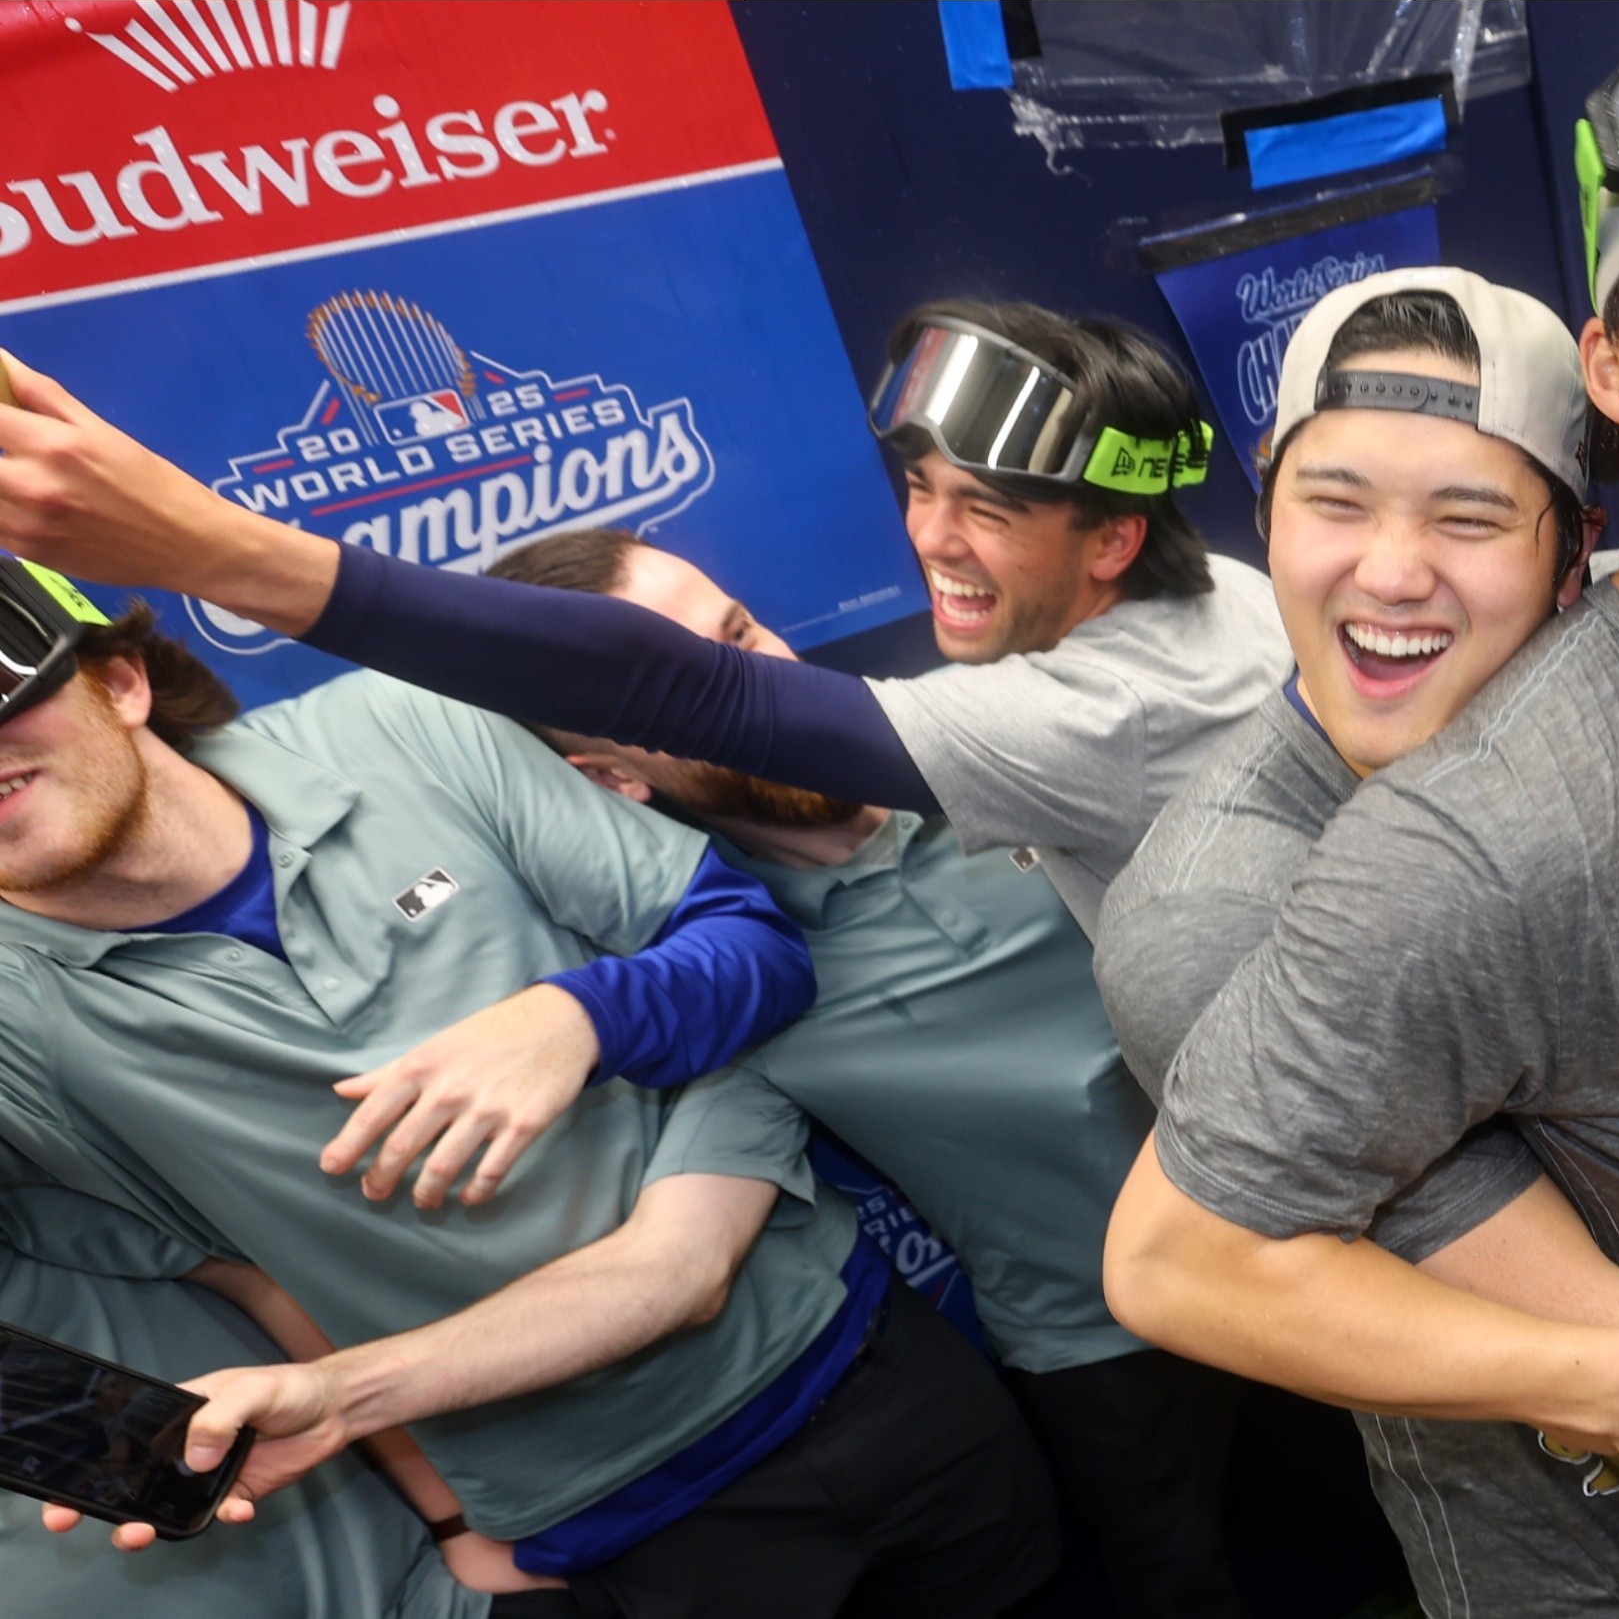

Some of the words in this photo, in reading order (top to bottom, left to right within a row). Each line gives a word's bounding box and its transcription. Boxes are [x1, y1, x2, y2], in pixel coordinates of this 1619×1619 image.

[234, 445, 433, 513] WORLD
[446, 396, 627, 462] SERIES
[297, 427, 362, 462] 20
[488, 382, 545, 416] 25
[285, 411, 702, 575] ampions
